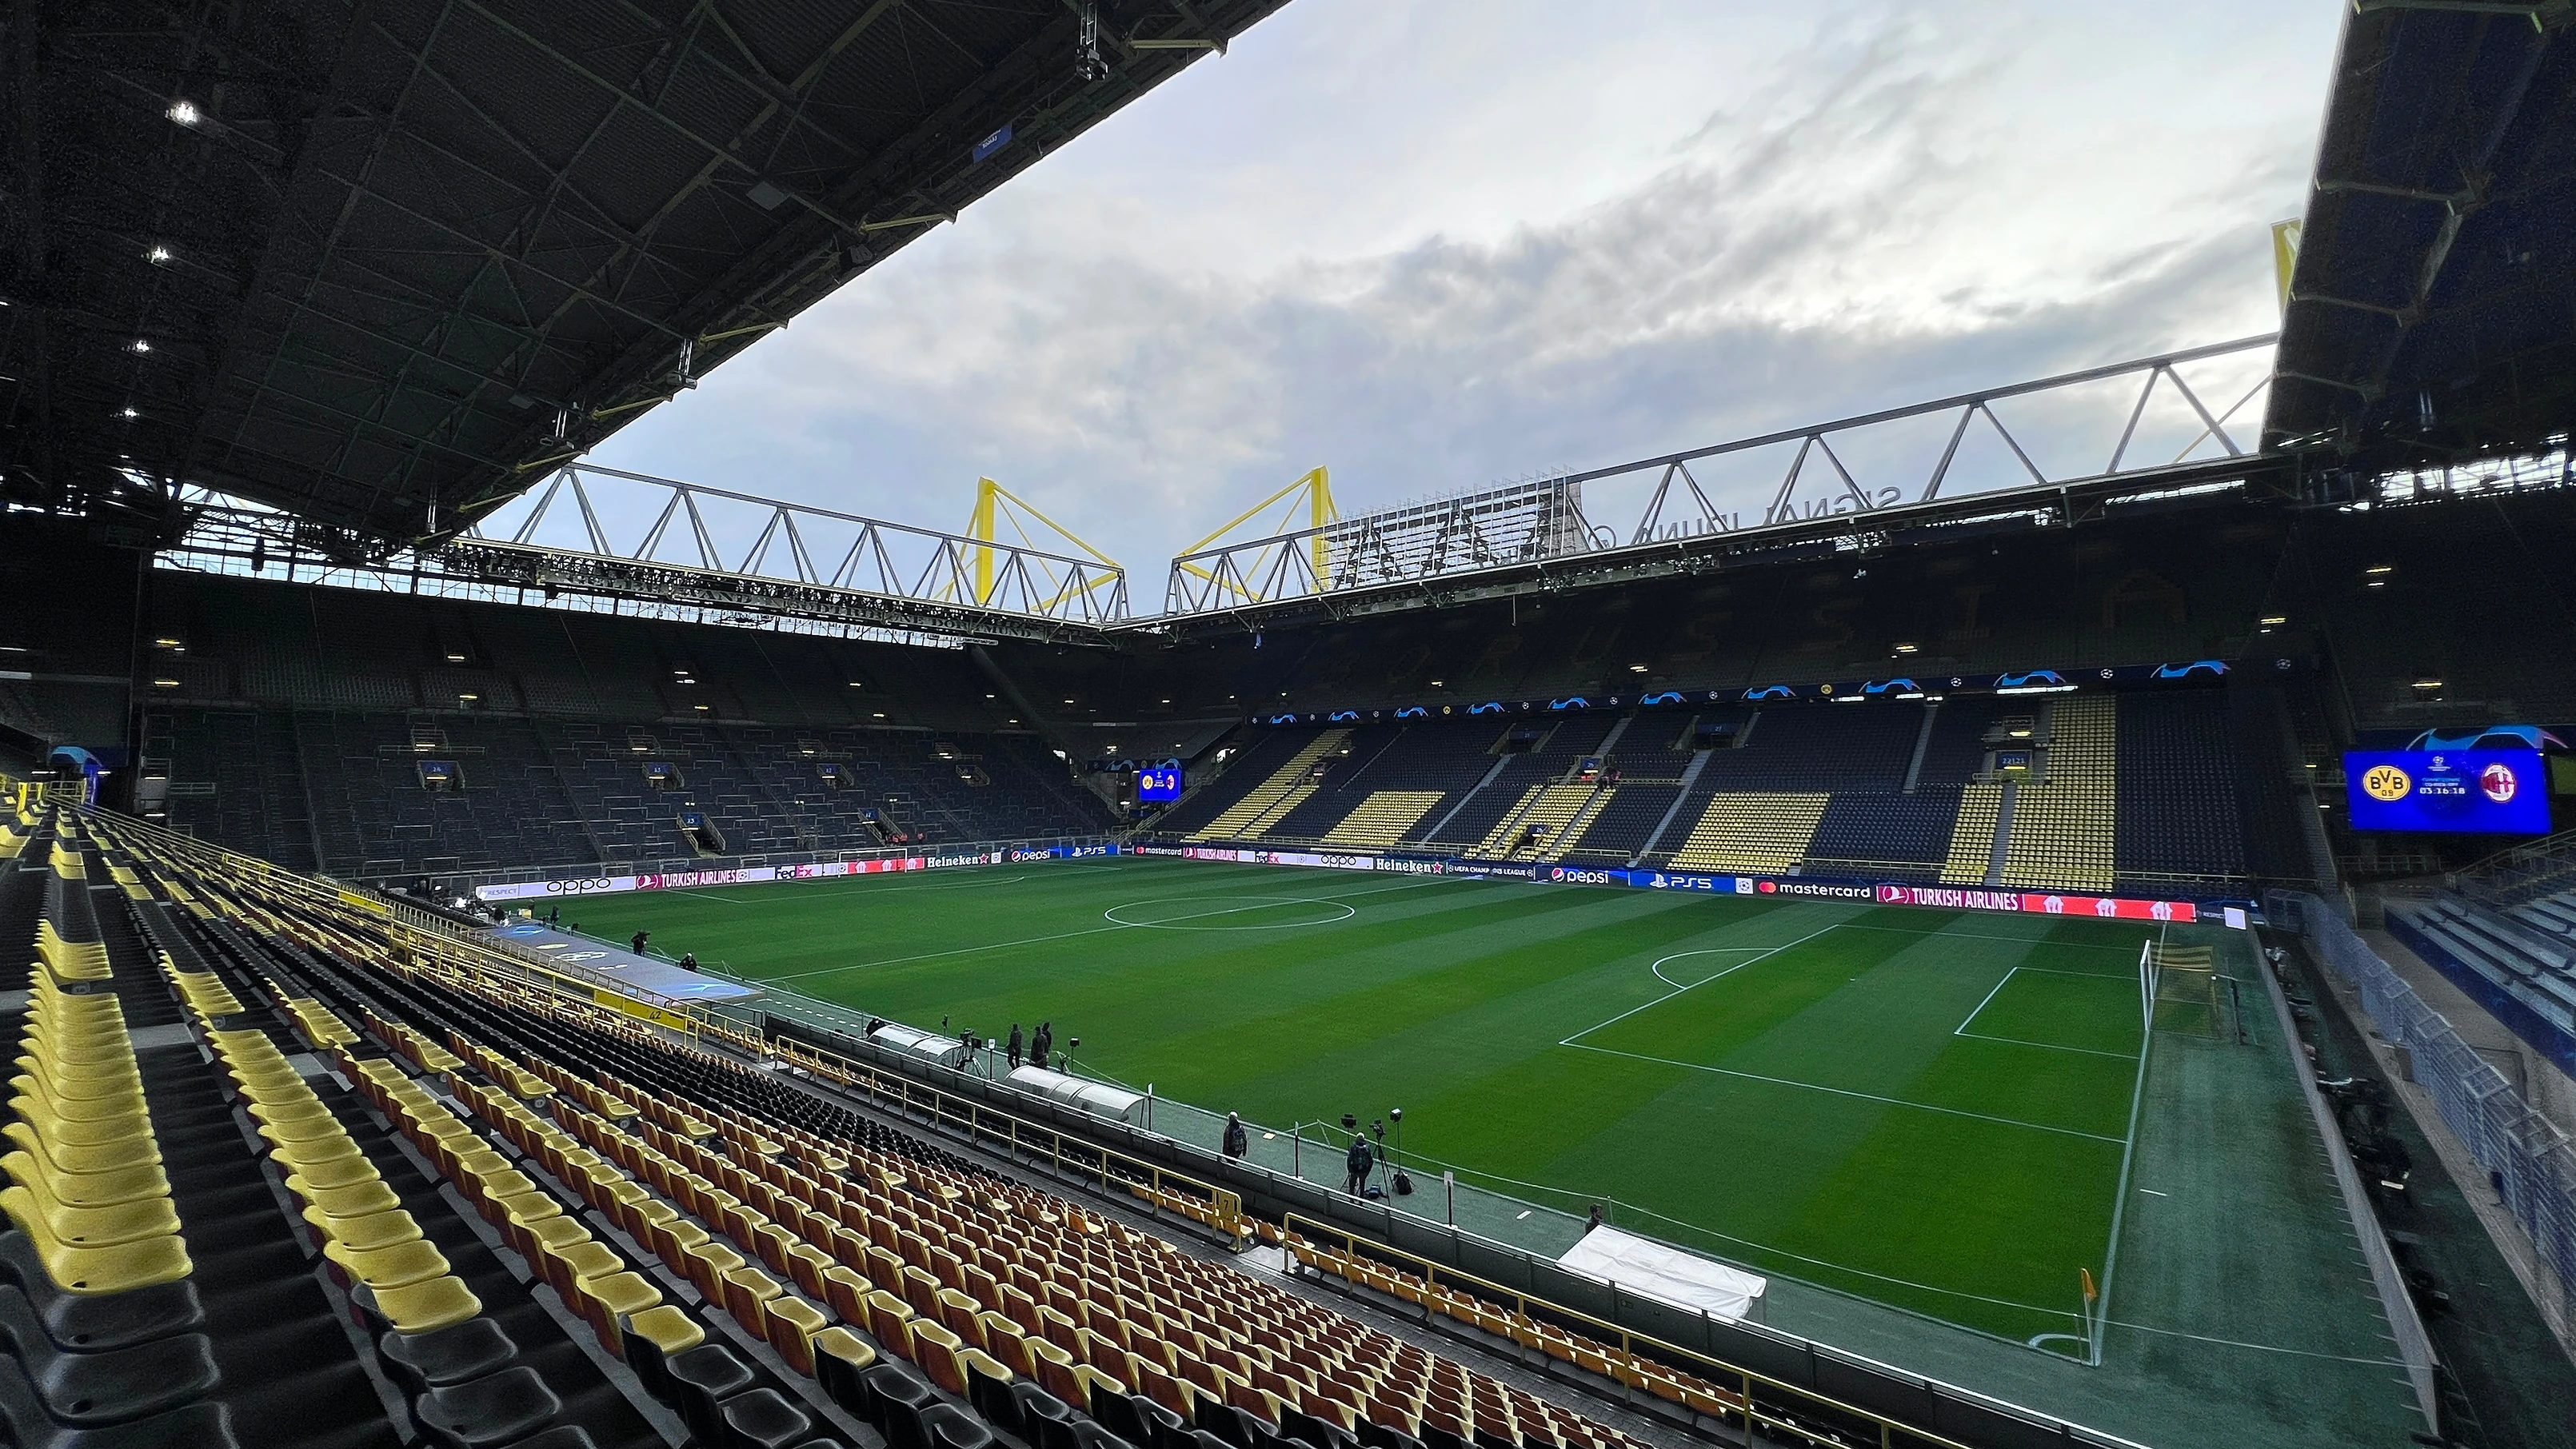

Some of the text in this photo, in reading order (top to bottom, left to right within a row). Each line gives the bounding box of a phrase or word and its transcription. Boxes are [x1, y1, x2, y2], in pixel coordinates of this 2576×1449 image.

[2370, 770, 2404, 789] BVB
[1022, 848, 1050, 861] pepsi
[1083, 846, 1106, 856] PS5
[1145, 847, 1182, 856] mastercard
[927, 854, 979, 868] Heineken
[1320, 855, 1356, 868] oppo
[1376, 858, 1432, 873] Heineken
[661, 869, 736, 888] TURKISH AIRLINES
[1567, 870, 1609, 884] pepsi
[1671, 876, 1712, 889] PS5
[546, 878, 611, 896] oppo
[1779, 881, 1871, 898] mastercard
[1912, 887, 2018, 911] TURKISH AIRLINES
